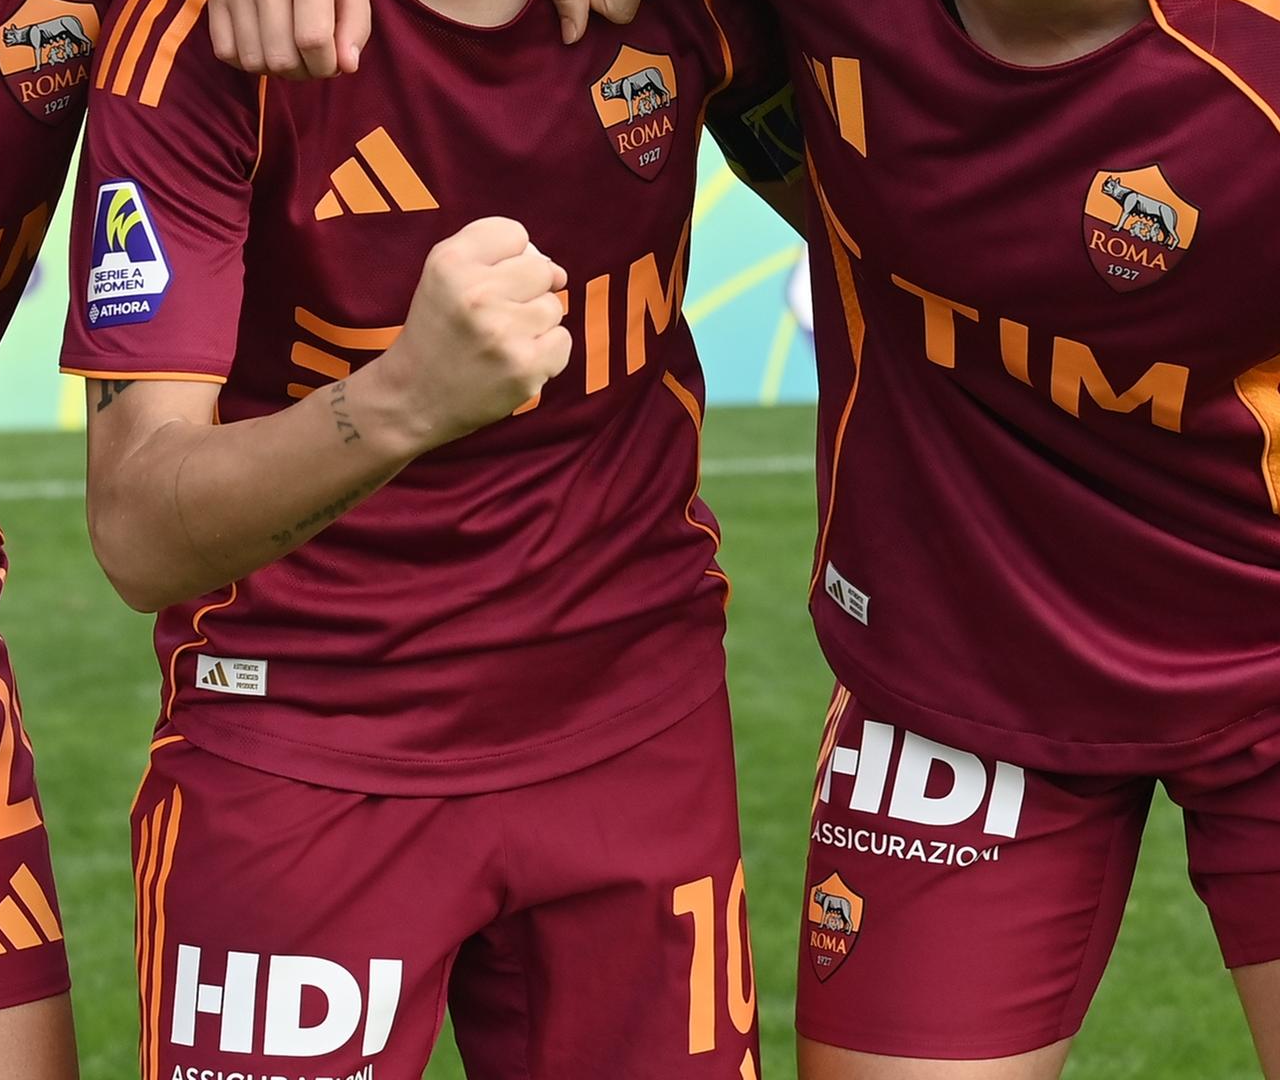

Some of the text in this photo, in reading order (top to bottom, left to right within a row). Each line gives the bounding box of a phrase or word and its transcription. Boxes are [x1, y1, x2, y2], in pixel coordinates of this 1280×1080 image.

[18, 64, 89, 103] ROMA
[44, 95, 71, 115] 1927
[616, 115, 674, 154] ROMA
[638, 147, 661, 166] 1927
[1089, 229, 1168, 271] ROMA
[93, 279, 144, 294] WOMEN
[94, 267, 142, 283] SERIE A
[1107, 264, 1139, 280] 1927
[100, 300, 150, 317] ATHORA
[891, 273, 1189, 433] TIM
[819, 720, 1025, 839] HDI
[811, 819, 999, 867] ASSICURAZIONI
[673, 858, 755, 1054] 10
[810, 930, 848, 954] ROMA
[170, 943, 403, 1058] HDI
